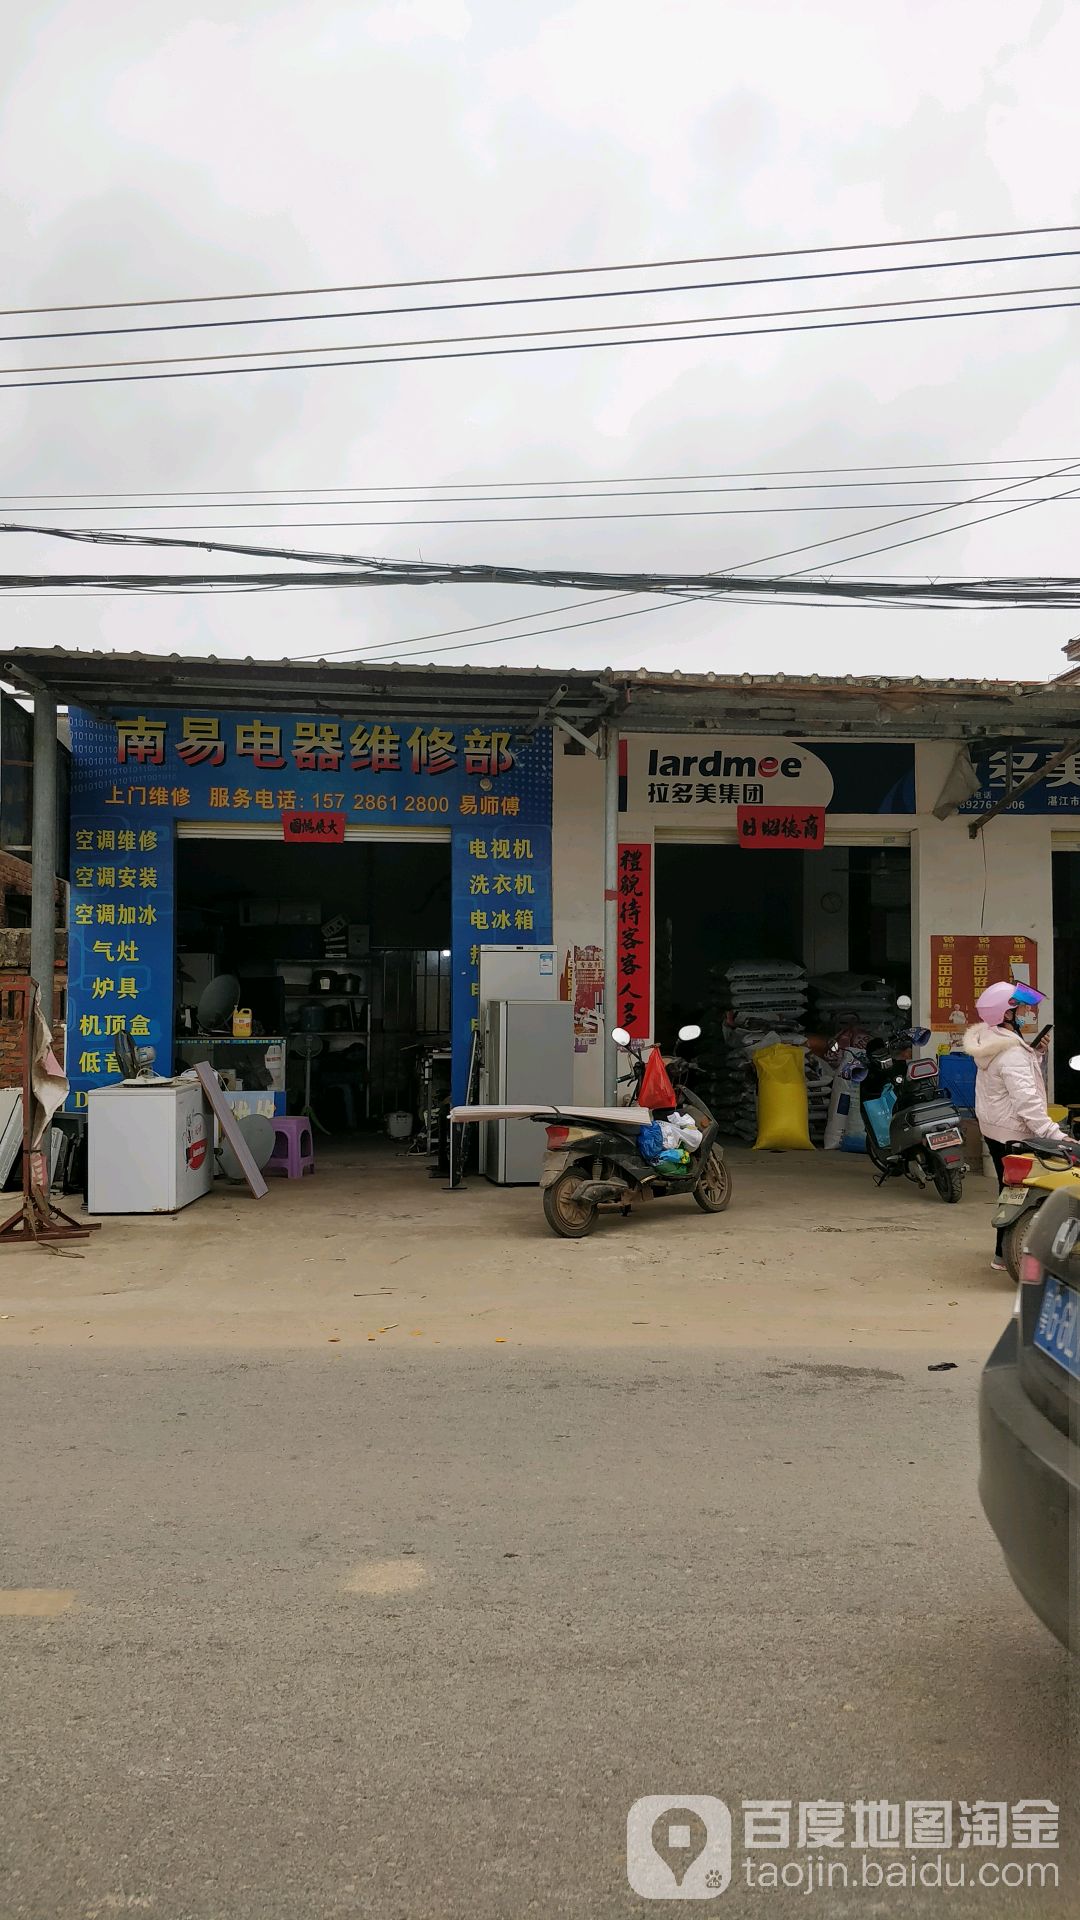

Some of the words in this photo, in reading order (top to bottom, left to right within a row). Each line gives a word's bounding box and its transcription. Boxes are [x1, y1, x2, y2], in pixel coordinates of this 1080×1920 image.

[116, 714, 514, 775] 南易电器维修部
[648, 750, 802, 778] lardmee
[105, 785, 191, 807] 上门维修
[648, 783, 764, 804] 拉多美集团
[311, 793, 345, 809] 157
[353, 794, 398, 811] 2861
[404, 796, 449, 812] 2800
[459, 795, 520, 816] 易师傅
[75, 830, 158, 851] 空调维修
[469, 838, 533, 859] 电视机
[75, 867, 158, 888] 空调安装
[469, 874, 535, 895] 洗衣机
[75, 904, 157, 925] 空调加冰
[470, 909, 534, 930] 电冰箱
[93, 941, 139, 962] 气灶
[92, 977, 139, 999] 炉具
[79, 1014, 150, 1036] 机顶盒
